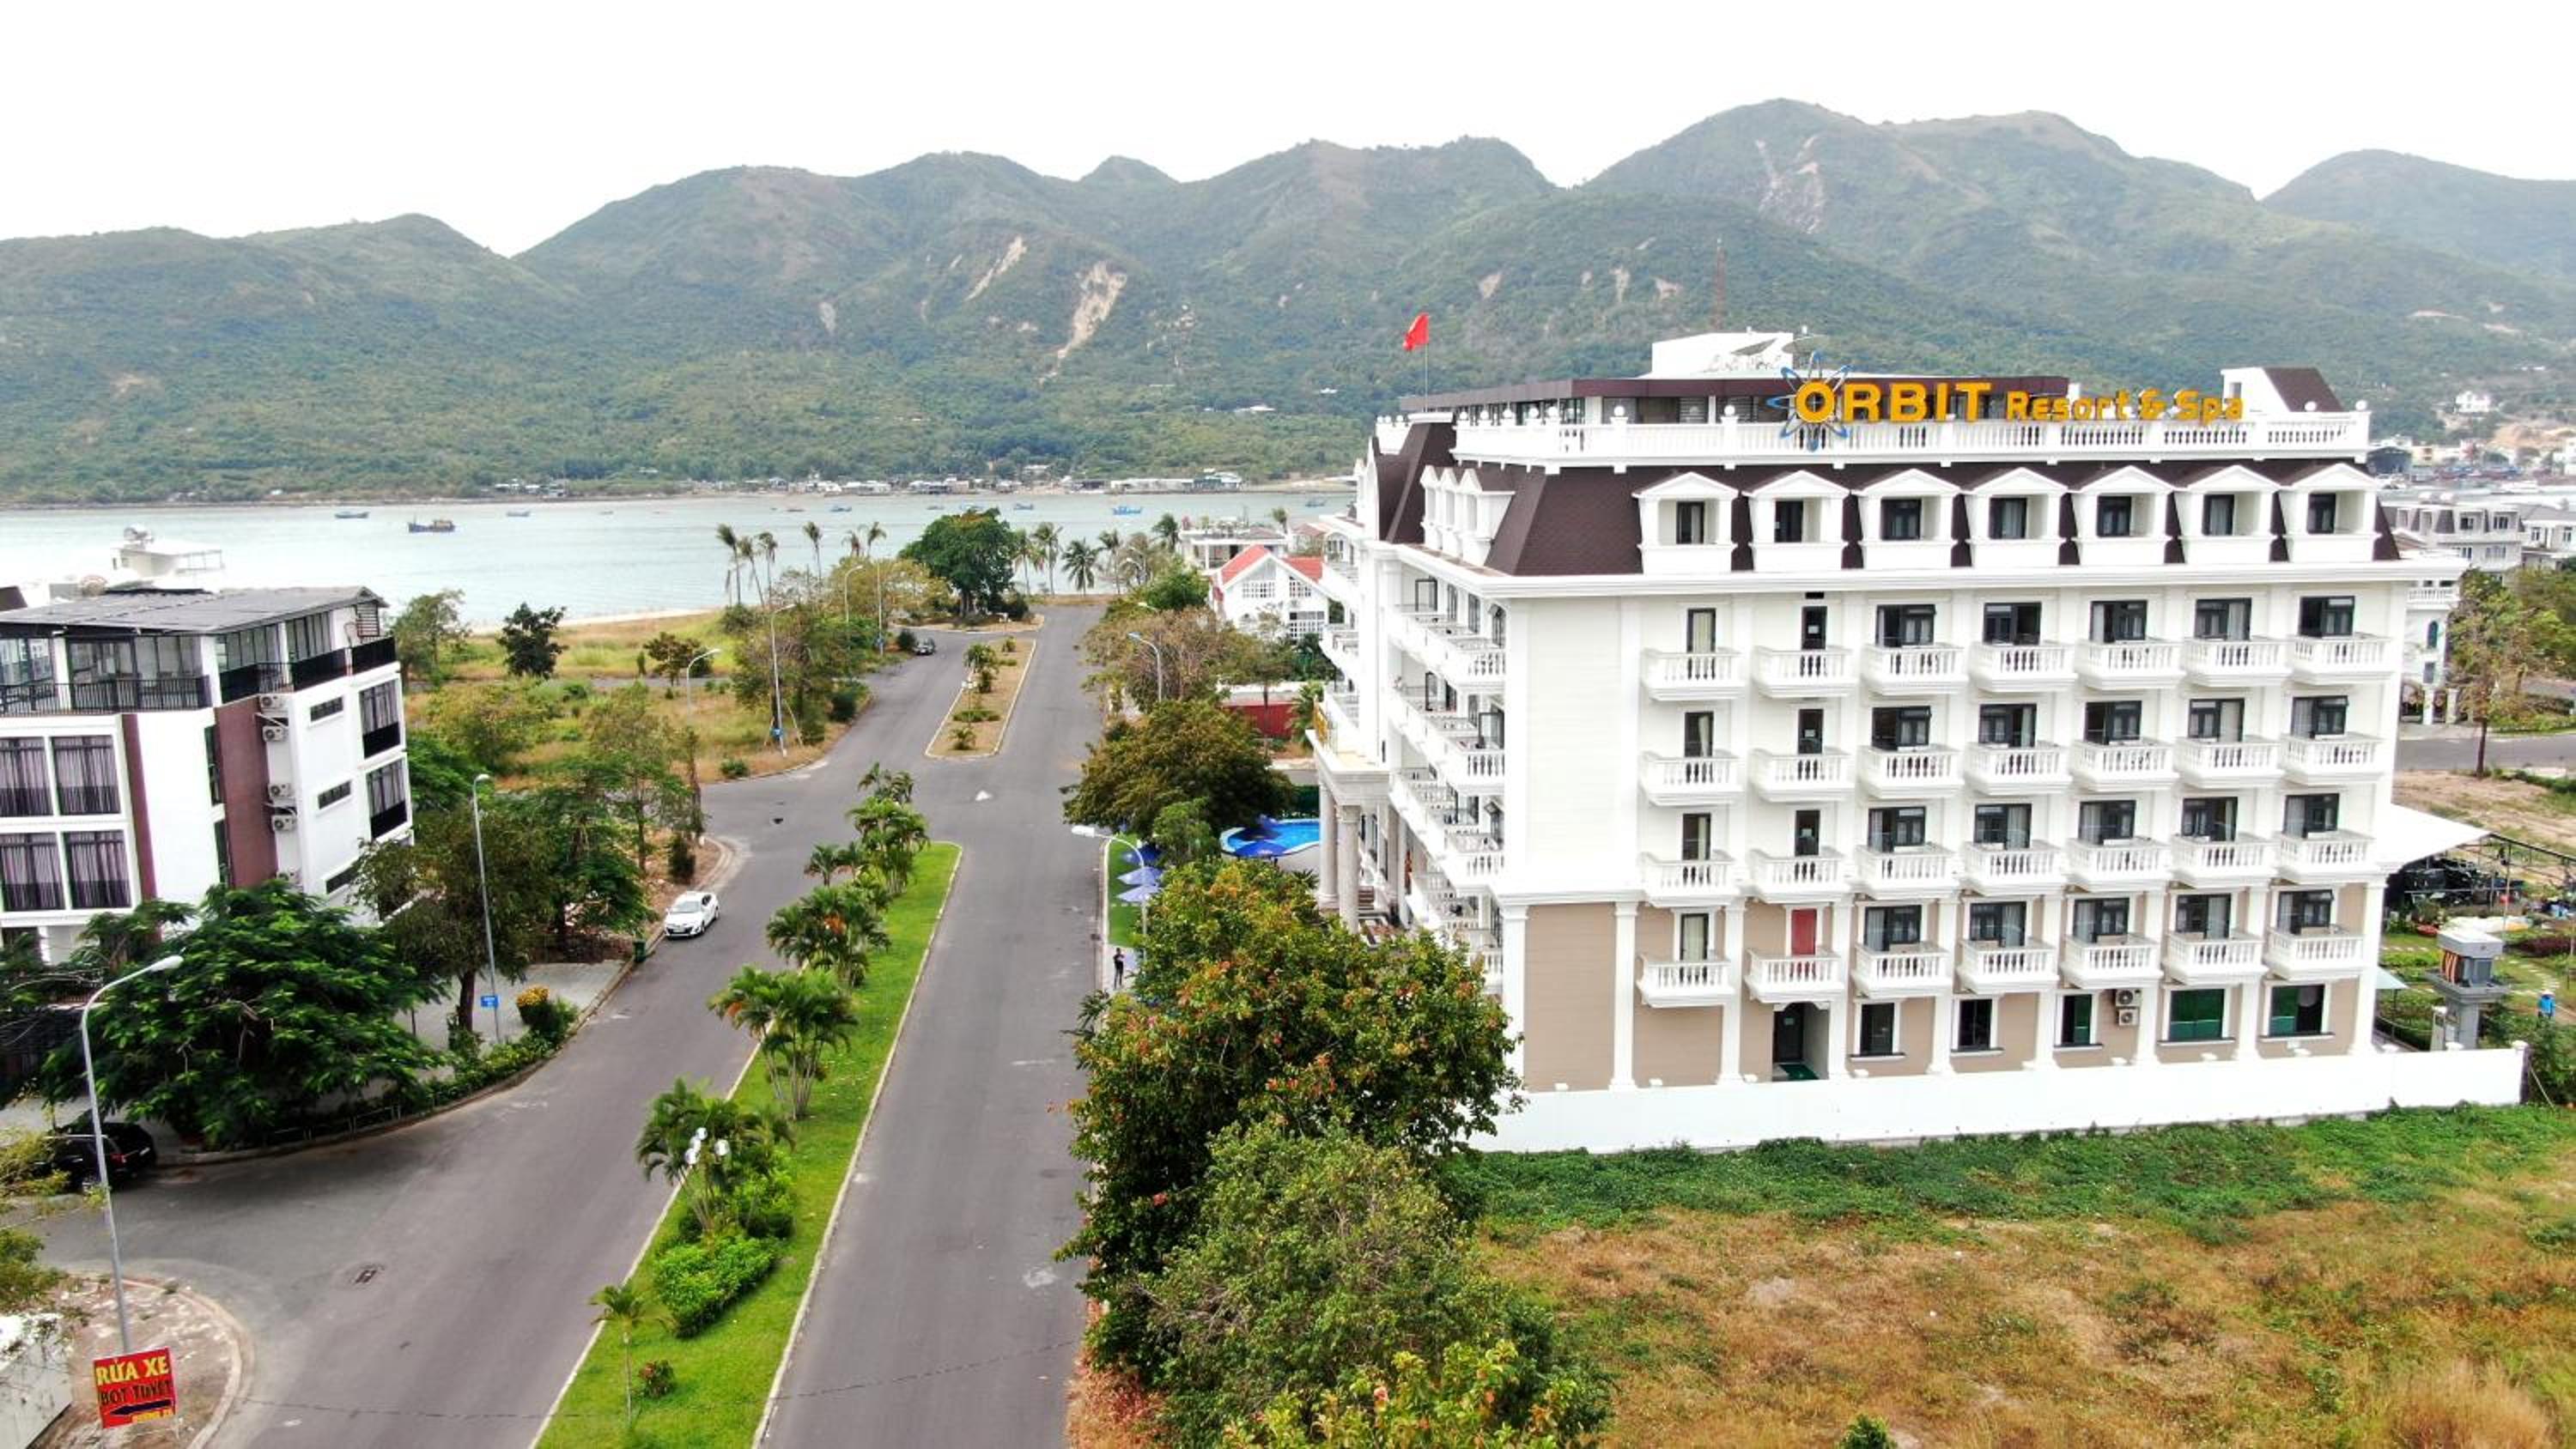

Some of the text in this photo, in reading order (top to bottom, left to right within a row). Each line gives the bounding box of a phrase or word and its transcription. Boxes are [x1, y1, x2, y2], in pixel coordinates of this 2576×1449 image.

[1795, 379, 2244, 427] ORBIT Resort & Spa
[143, 1355, 169, 1378] XE
